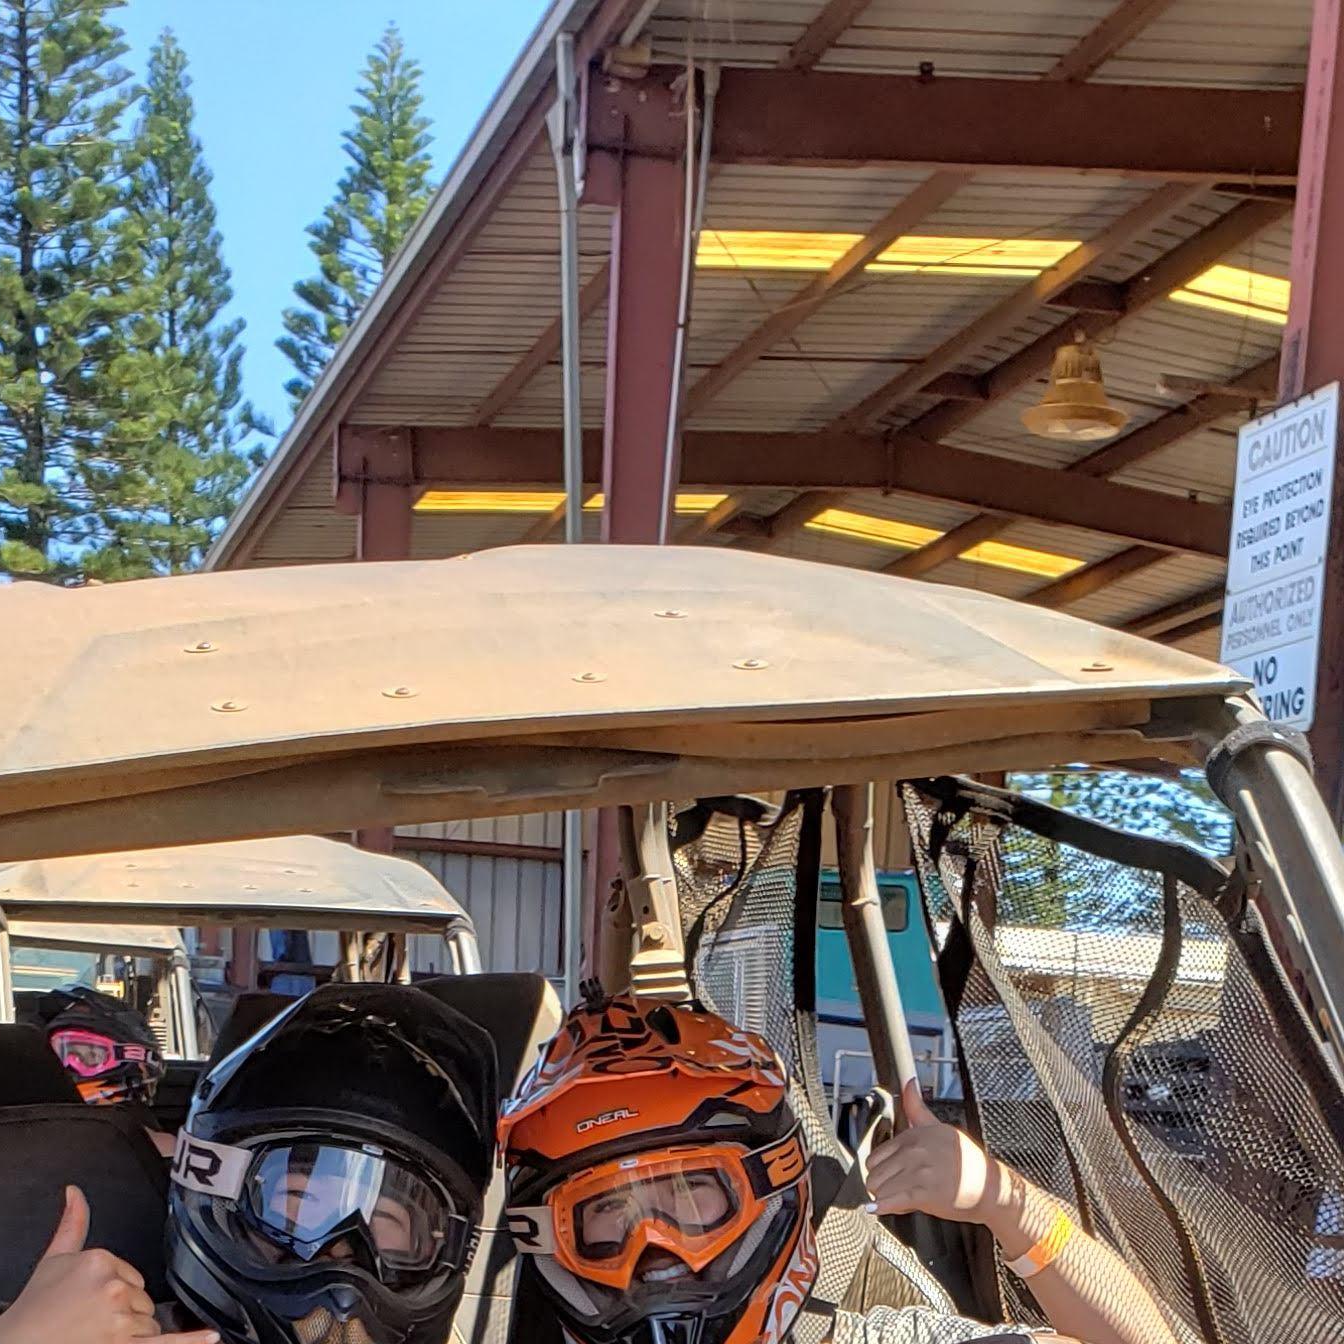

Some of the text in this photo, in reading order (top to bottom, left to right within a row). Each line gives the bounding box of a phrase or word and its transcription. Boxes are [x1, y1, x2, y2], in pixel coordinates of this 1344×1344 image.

[1248, 410, 1327, 471] CAUTION
[1243, 468, 1323, 518] EYE PROTECTION
[1237, 498, 1324, 550] REQUIRED BEYOND
[1251, 537, 1304, 573] THIS POINT
[1229, 575, 1315, 627] AUTHORIZED
[1225, 607, 1314, 651] PERSONNEL ONLY
[1253, 656, 1278, 686] NO
[1258, 686, 1304, 721] RING
